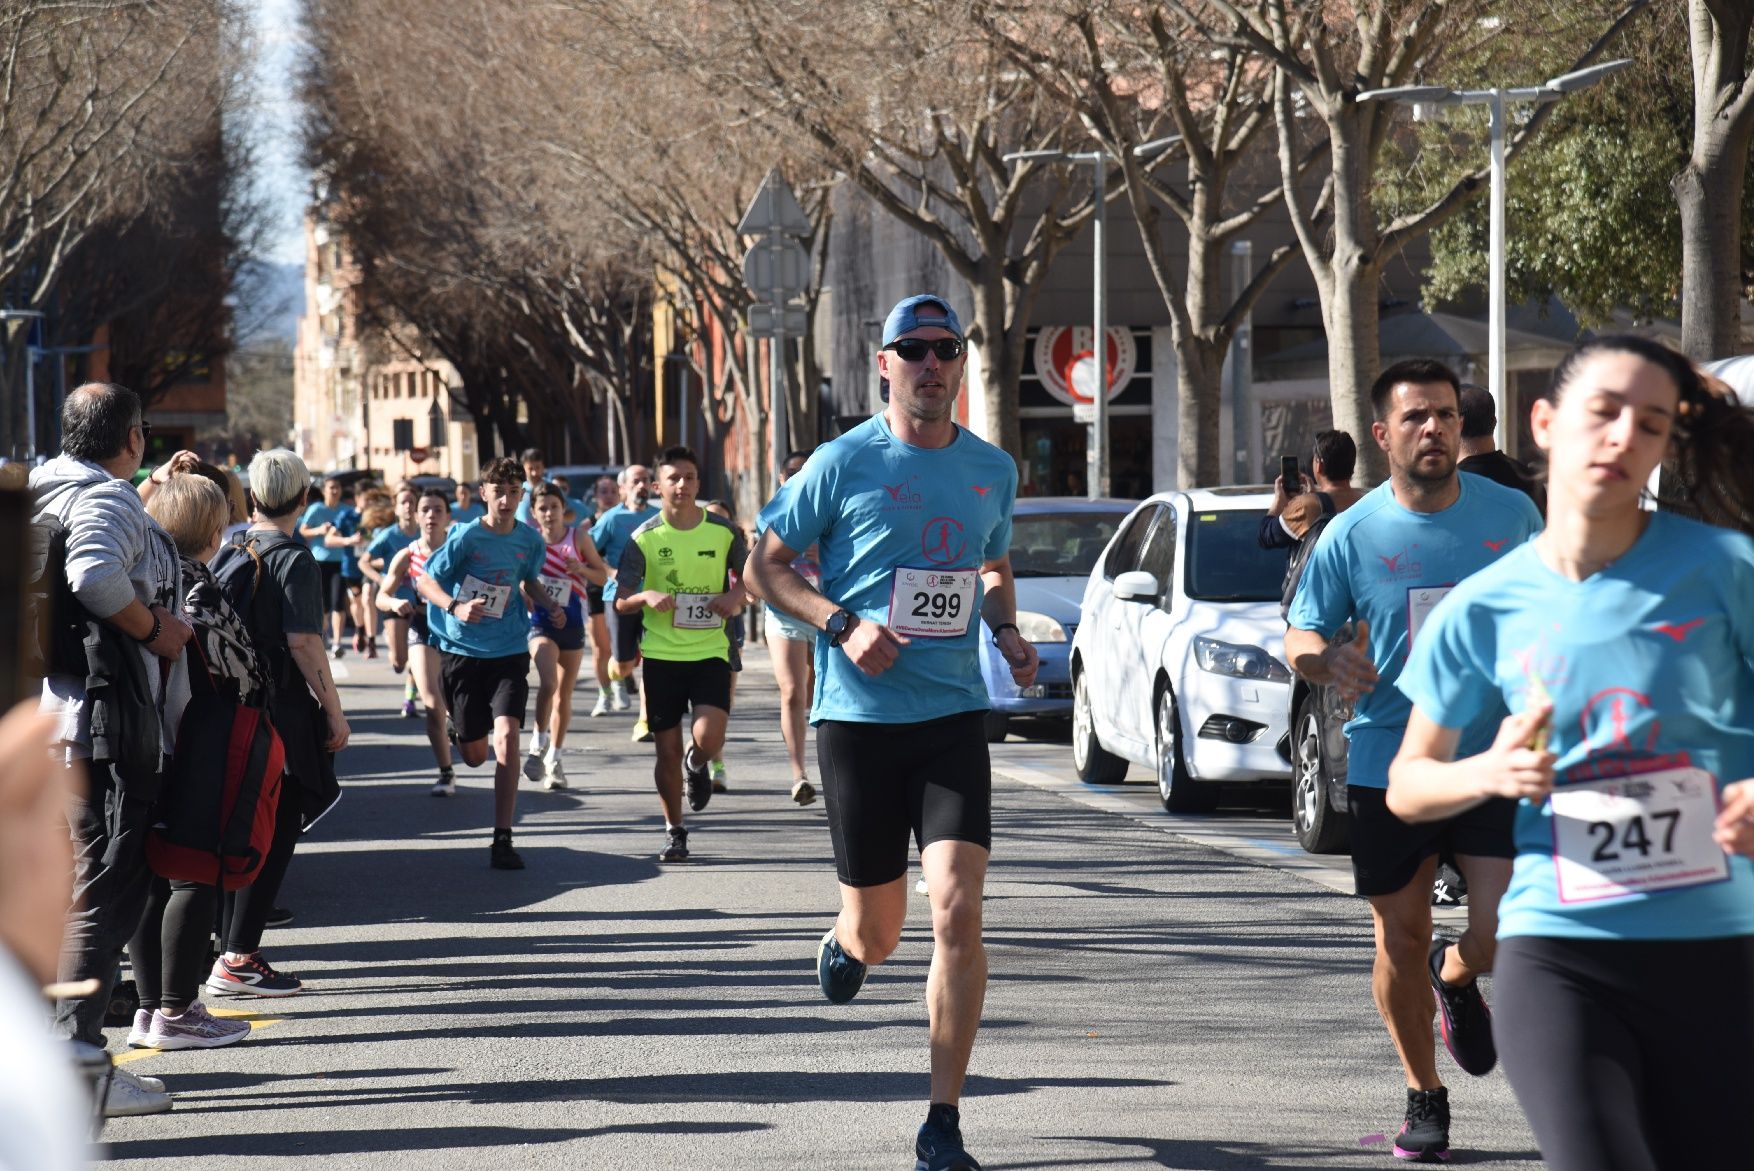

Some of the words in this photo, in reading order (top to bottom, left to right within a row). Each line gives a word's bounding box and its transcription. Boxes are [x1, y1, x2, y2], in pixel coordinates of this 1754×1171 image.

[544, 585, 563, 598] 67
[911, 592, 961, 618] 299
[1587, 809, 1681, 862] 247
